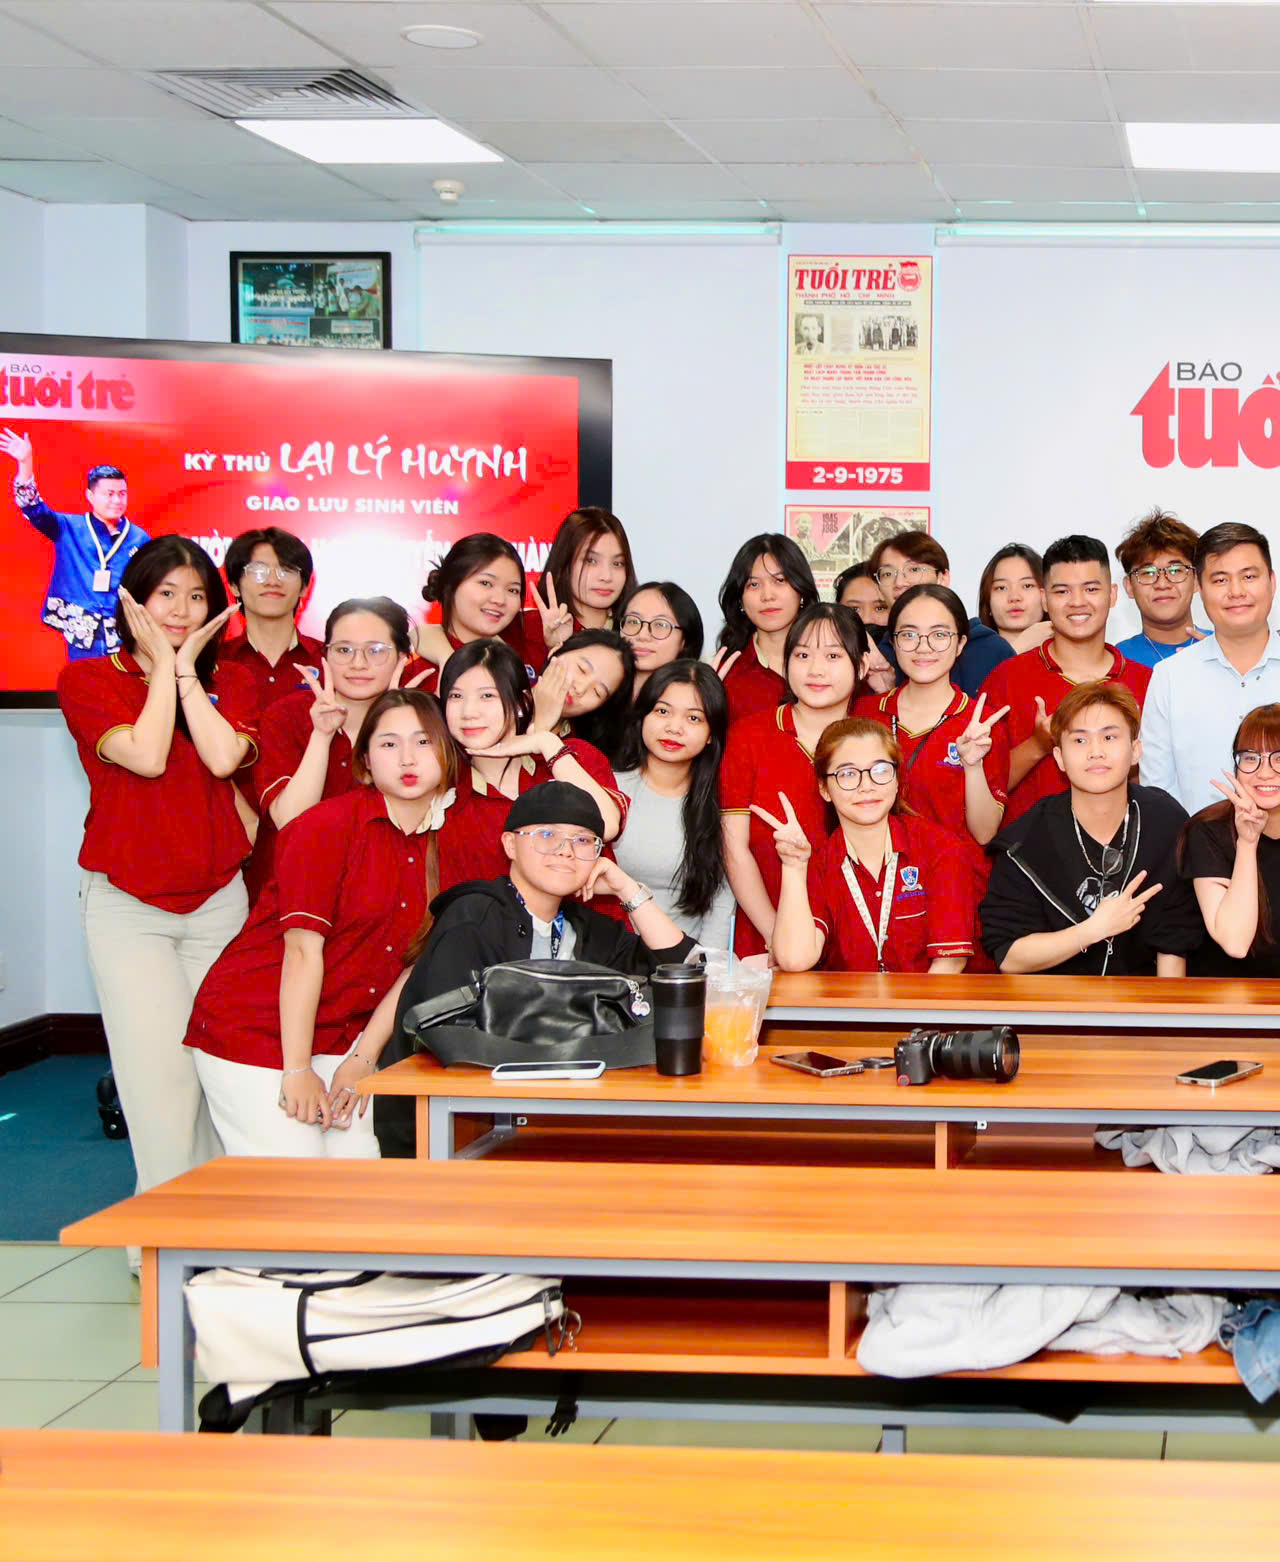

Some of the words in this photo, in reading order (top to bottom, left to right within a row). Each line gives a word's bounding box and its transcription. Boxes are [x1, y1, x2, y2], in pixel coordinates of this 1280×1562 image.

[1176, 359, 1243, 381] BÁO
[223, 451, 272, 472] THỦ
[280, 441, 334, 480] LẠI
[348, 434, 391, 480] LÝ
[812, 467, 903, 485] 2-9-1975
[246, 495, 301, 511] GIAO
[308, 497, 348, 513] LƯU
[355, 498, 405, 513] SINH
[410, 497, 459, 515] VIÊN
